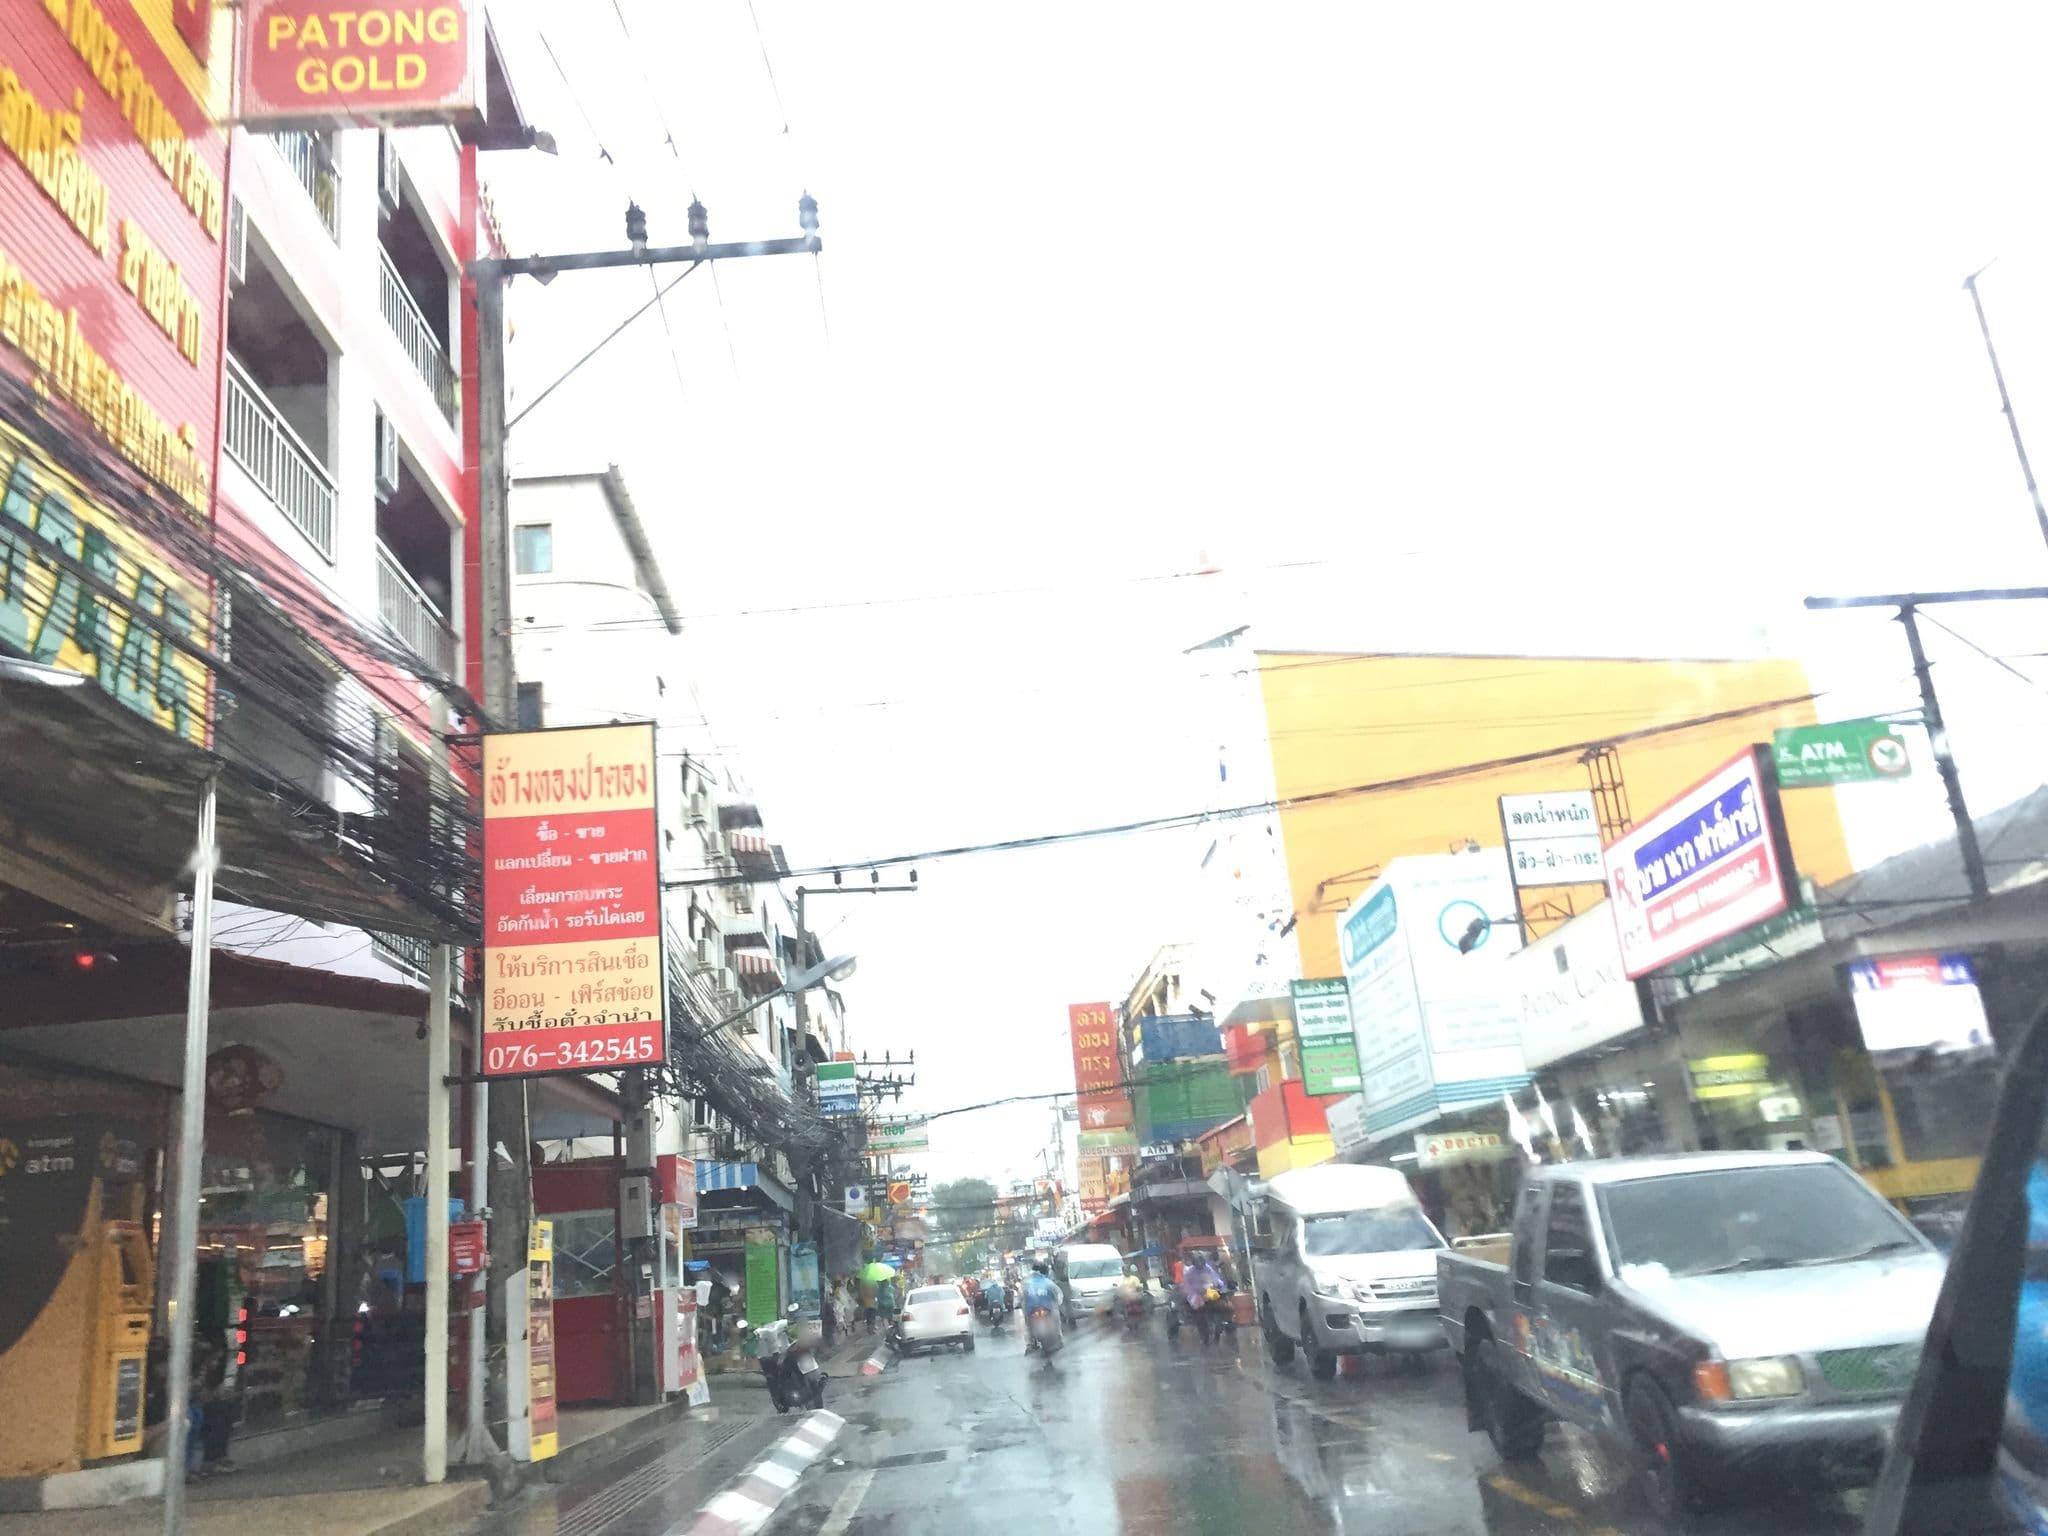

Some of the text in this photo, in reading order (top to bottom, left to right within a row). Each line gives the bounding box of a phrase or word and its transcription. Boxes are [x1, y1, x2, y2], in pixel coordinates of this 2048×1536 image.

[267, 7, 460, 50] PATONG
[295, 53, 427, 94] GOLD
[1801, 740, 1848, 760] ATM
[1511, 799, 1590, 825] ลดน้ำหนัก
[535, 820, 559, 841] ซื้อ
[575, 825, 606, 839] ขาย
[494, 847, 572, 871] แลกเปลี่ยน
[589, 847, 648, 865] ขายฝาก
[519, 884, 624, 905] เลี่ยมกรอบพระ
[497, 903, 646, 933] อัดกันน้ำ รอรับได้เลย
[496, 942, 650, 979] ให้บริการสินเชื่อ
[488, 1035, 654, 1071] 076-342545
[25, 1155, 75, 1174] atm
